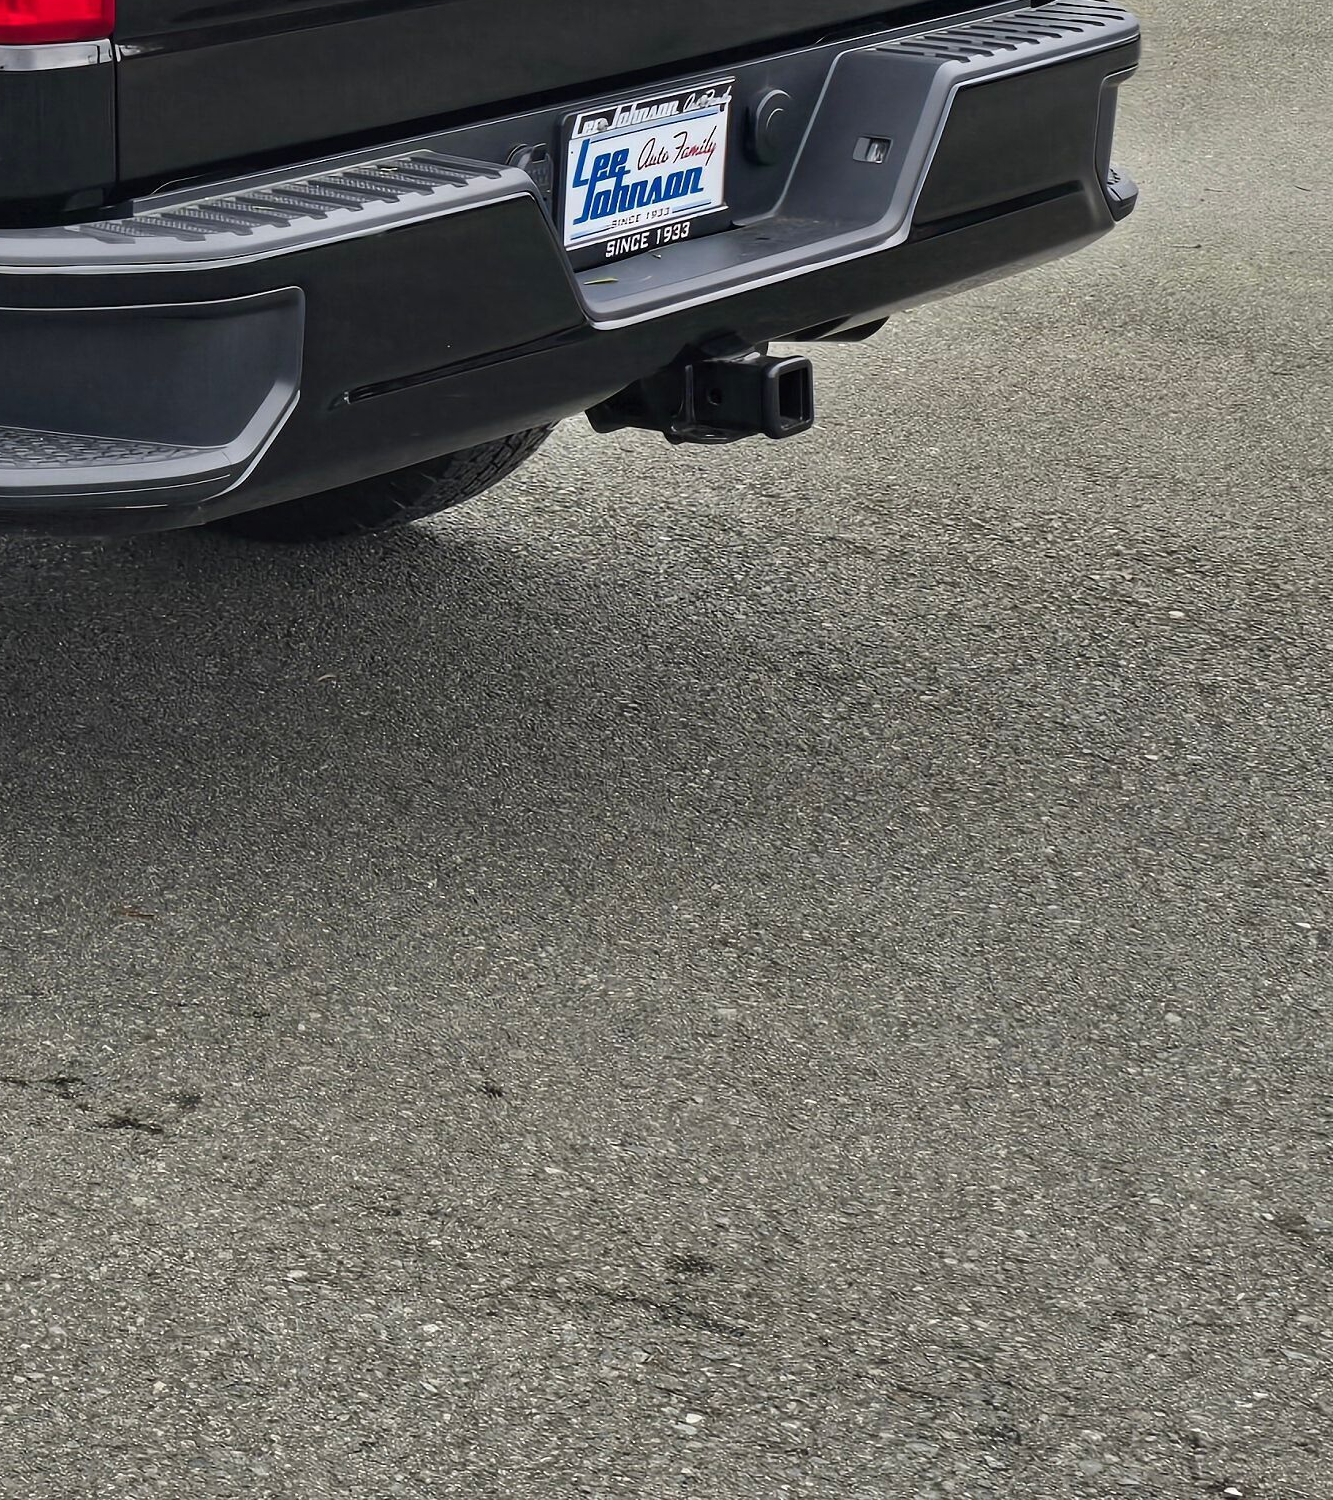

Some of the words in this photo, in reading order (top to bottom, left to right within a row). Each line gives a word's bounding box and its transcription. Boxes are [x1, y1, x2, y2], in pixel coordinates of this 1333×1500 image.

[607, 101, 680, 130] Johnson
[573, 138, 631, 188] Lee
[638, 138, 669, 170] Auto
[673, 126, 717, 166] Family
[573, 166, 704, 225] Johnson
[610, 213, 641, 229] SINCE
[645, 206, 671, 220] 1933
[605, 231, 650, 258] SINCE
[655, 221, 691, 245] 1933
